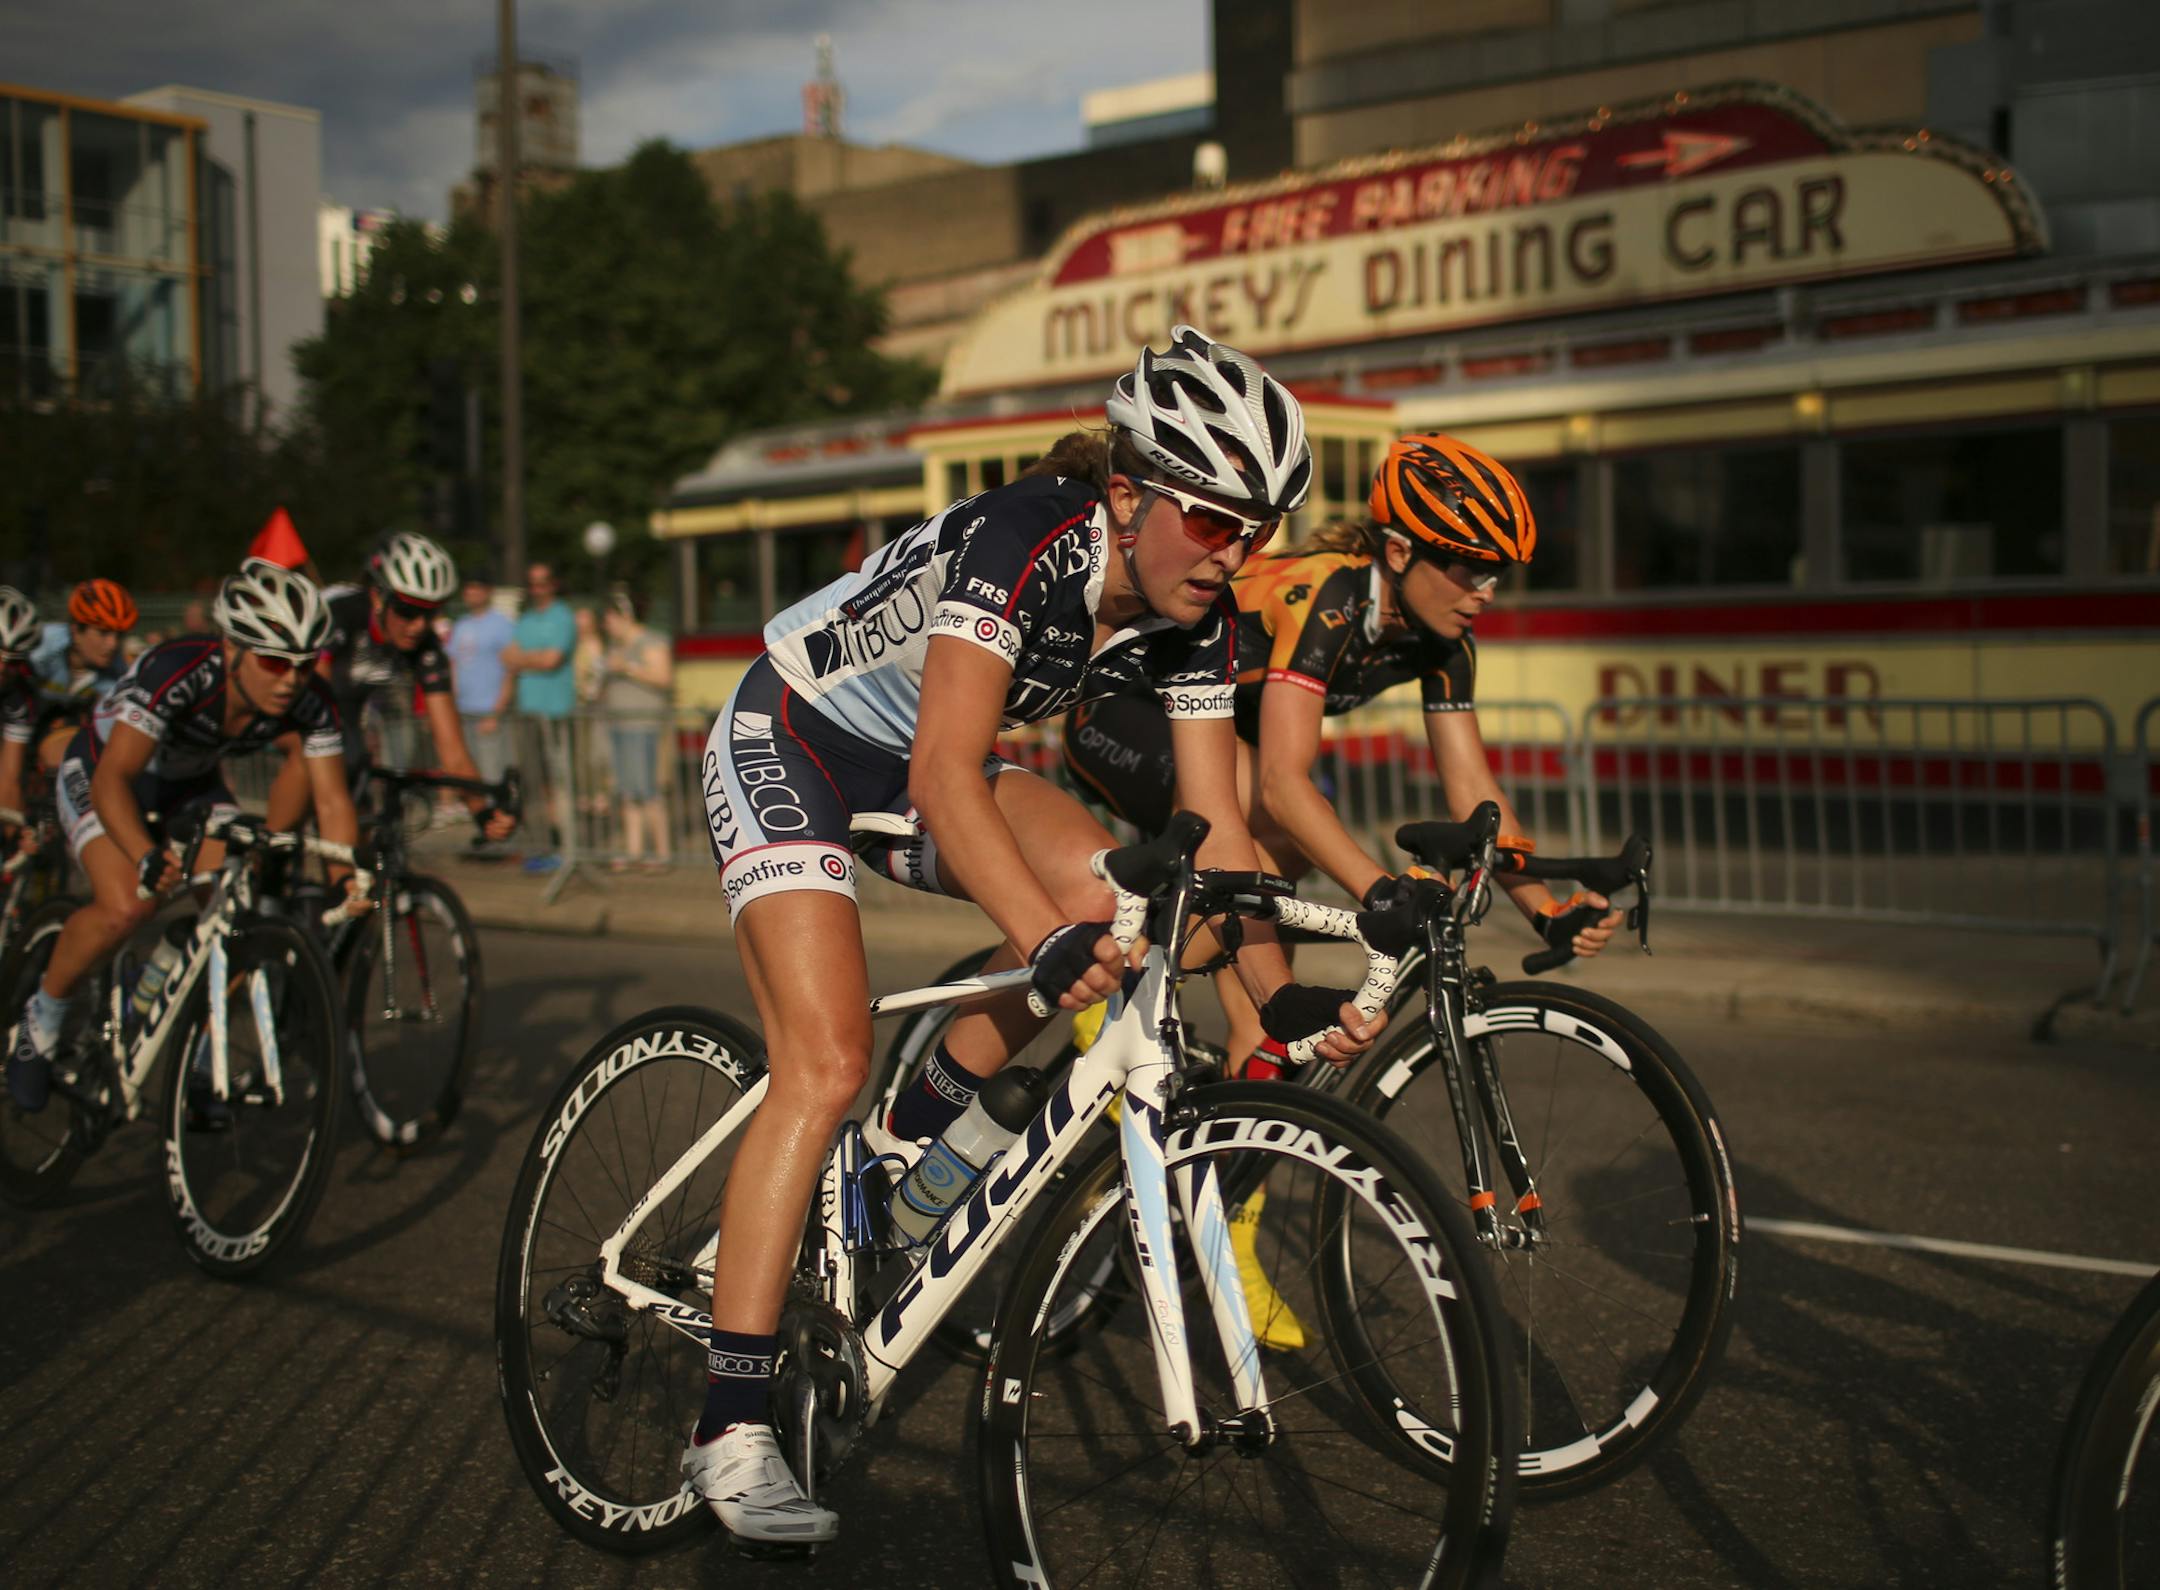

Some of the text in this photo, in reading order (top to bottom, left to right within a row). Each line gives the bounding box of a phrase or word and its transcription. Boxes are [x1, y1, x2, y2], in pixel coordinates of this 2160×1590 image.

[1220, 145, 1588, 252] FREE PARKING
[1363, 210, 1615, 317] DINING
[1665, 173, 1846, 272] CAR
[1149, 450, 1218, 486] RUDY
[966, 576, 1009, 606] FRS
[1597, 660, 1882, 734] DINER
[733, 741, 809, 832] TIBCO
[1079, 725, 1142, 773] OPTUM
[702, 750, 733, 833] SVB
[727, 859, 804, 899] Spotfire
[541, 1030, 742, 1160] REYNOLDS
[165, 1138, 270, 1262] REYNOLDS
[881, 1074, 1078, 1347] FUJI
[913, 1168, 947, 1208] FORMANCE
[1164, 1117, 1457, 1300] REYNOLD
[544, 1468, 705, 1532] REYNOL
